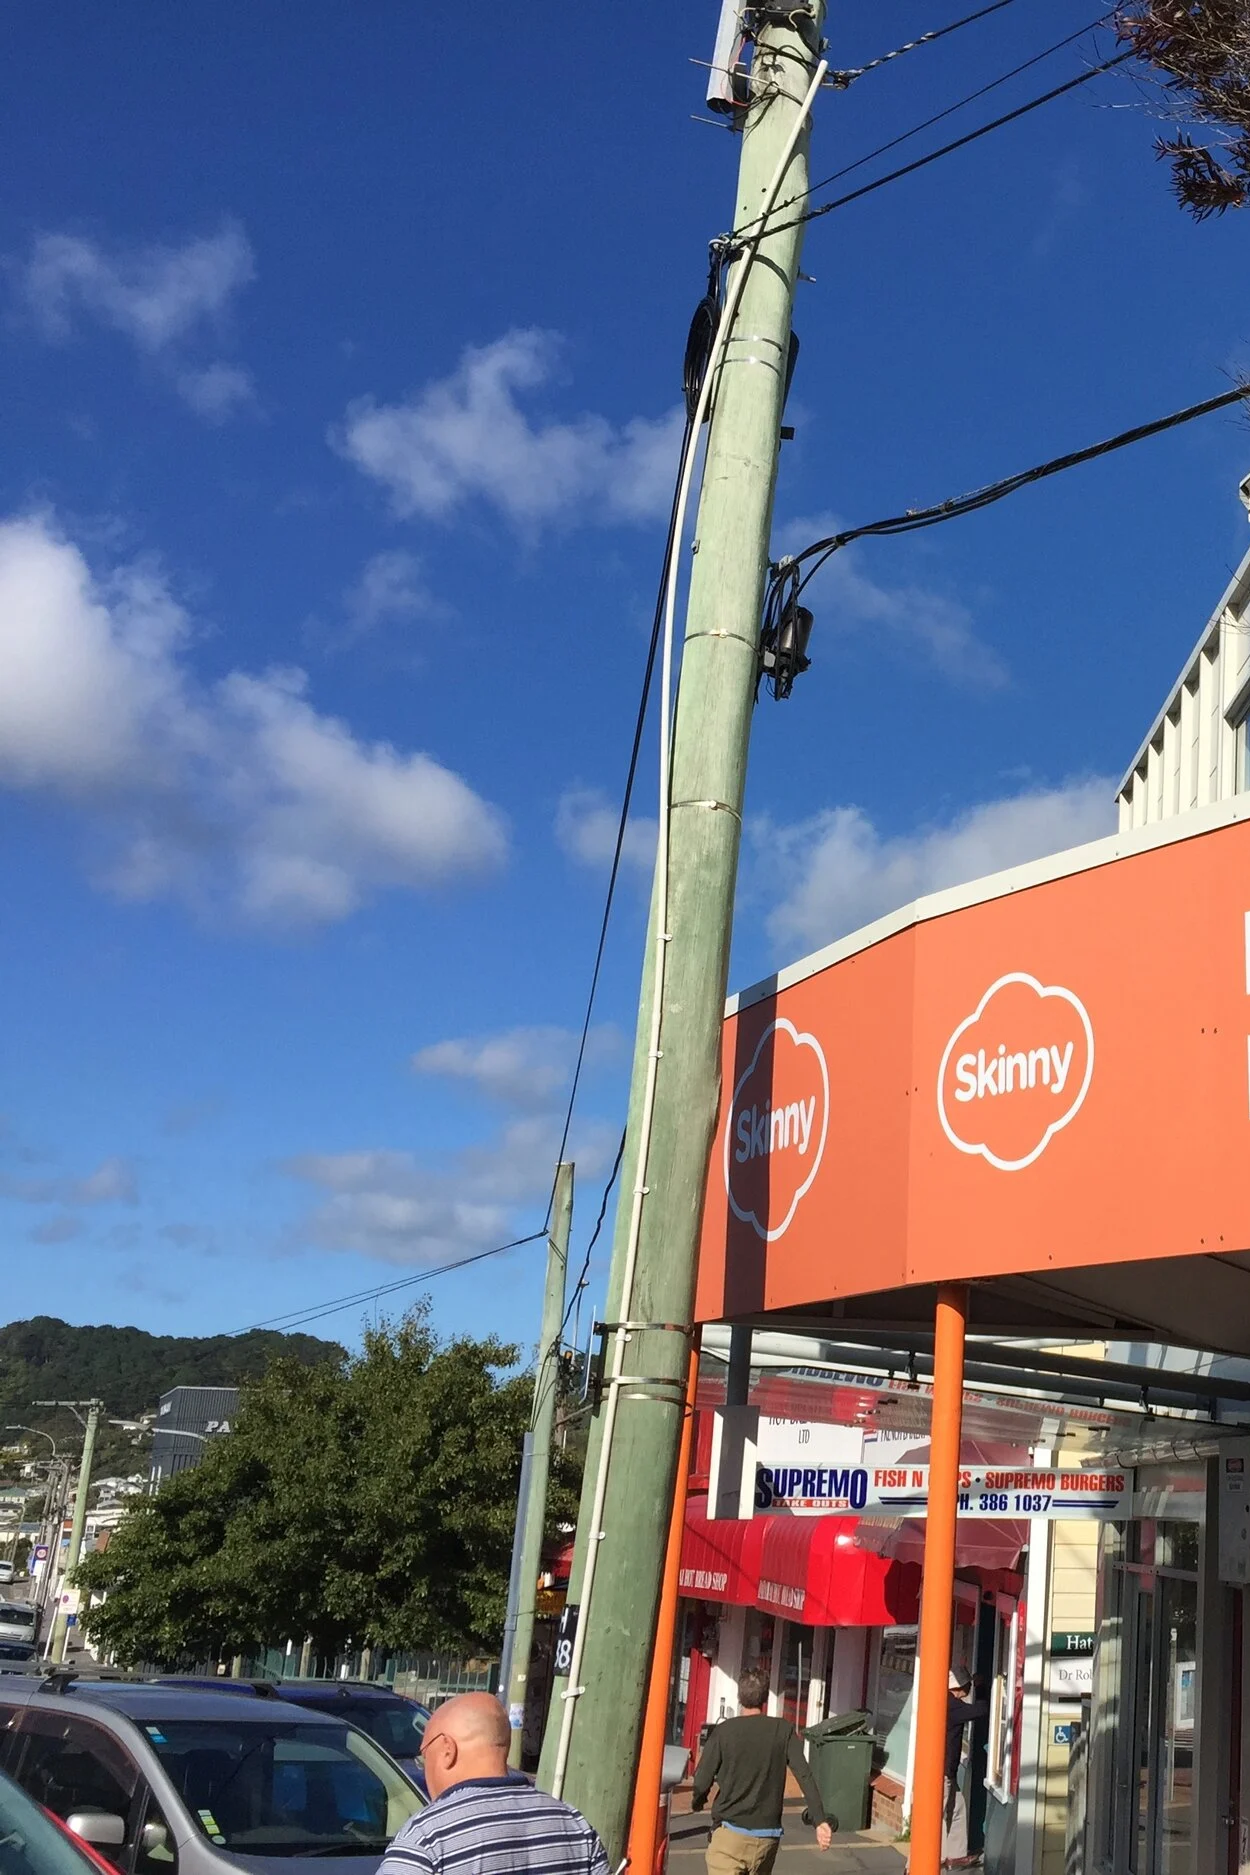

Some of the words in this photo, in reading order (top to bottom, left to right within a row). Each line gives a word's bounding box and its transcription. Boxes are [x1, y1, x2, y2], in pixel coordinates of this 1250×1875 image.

[955, 1040, 1074, 1103] Skinny
[735, 1095, 816, 1164] Skinny
[798, 1429, 811, 1444] LTD
[755, 1468, 868, 1509] SUPREMO
[874, 1470, 907, 1488] FISH
[912, 1470, 924, 1488] N
[985, 1471, 1055, 1490] SUPREMO
[1060, 1474, 1125, 1492] BURGERS
[775, 1499, 811, 1508] TAKE
[813, 1499, 849, 1508] OUTS
[979, 1493, 1008, 1511] 386
[1015, 1494, 1053, 1512] 1037
[1058, 1669, 1073, 1681] Dr
